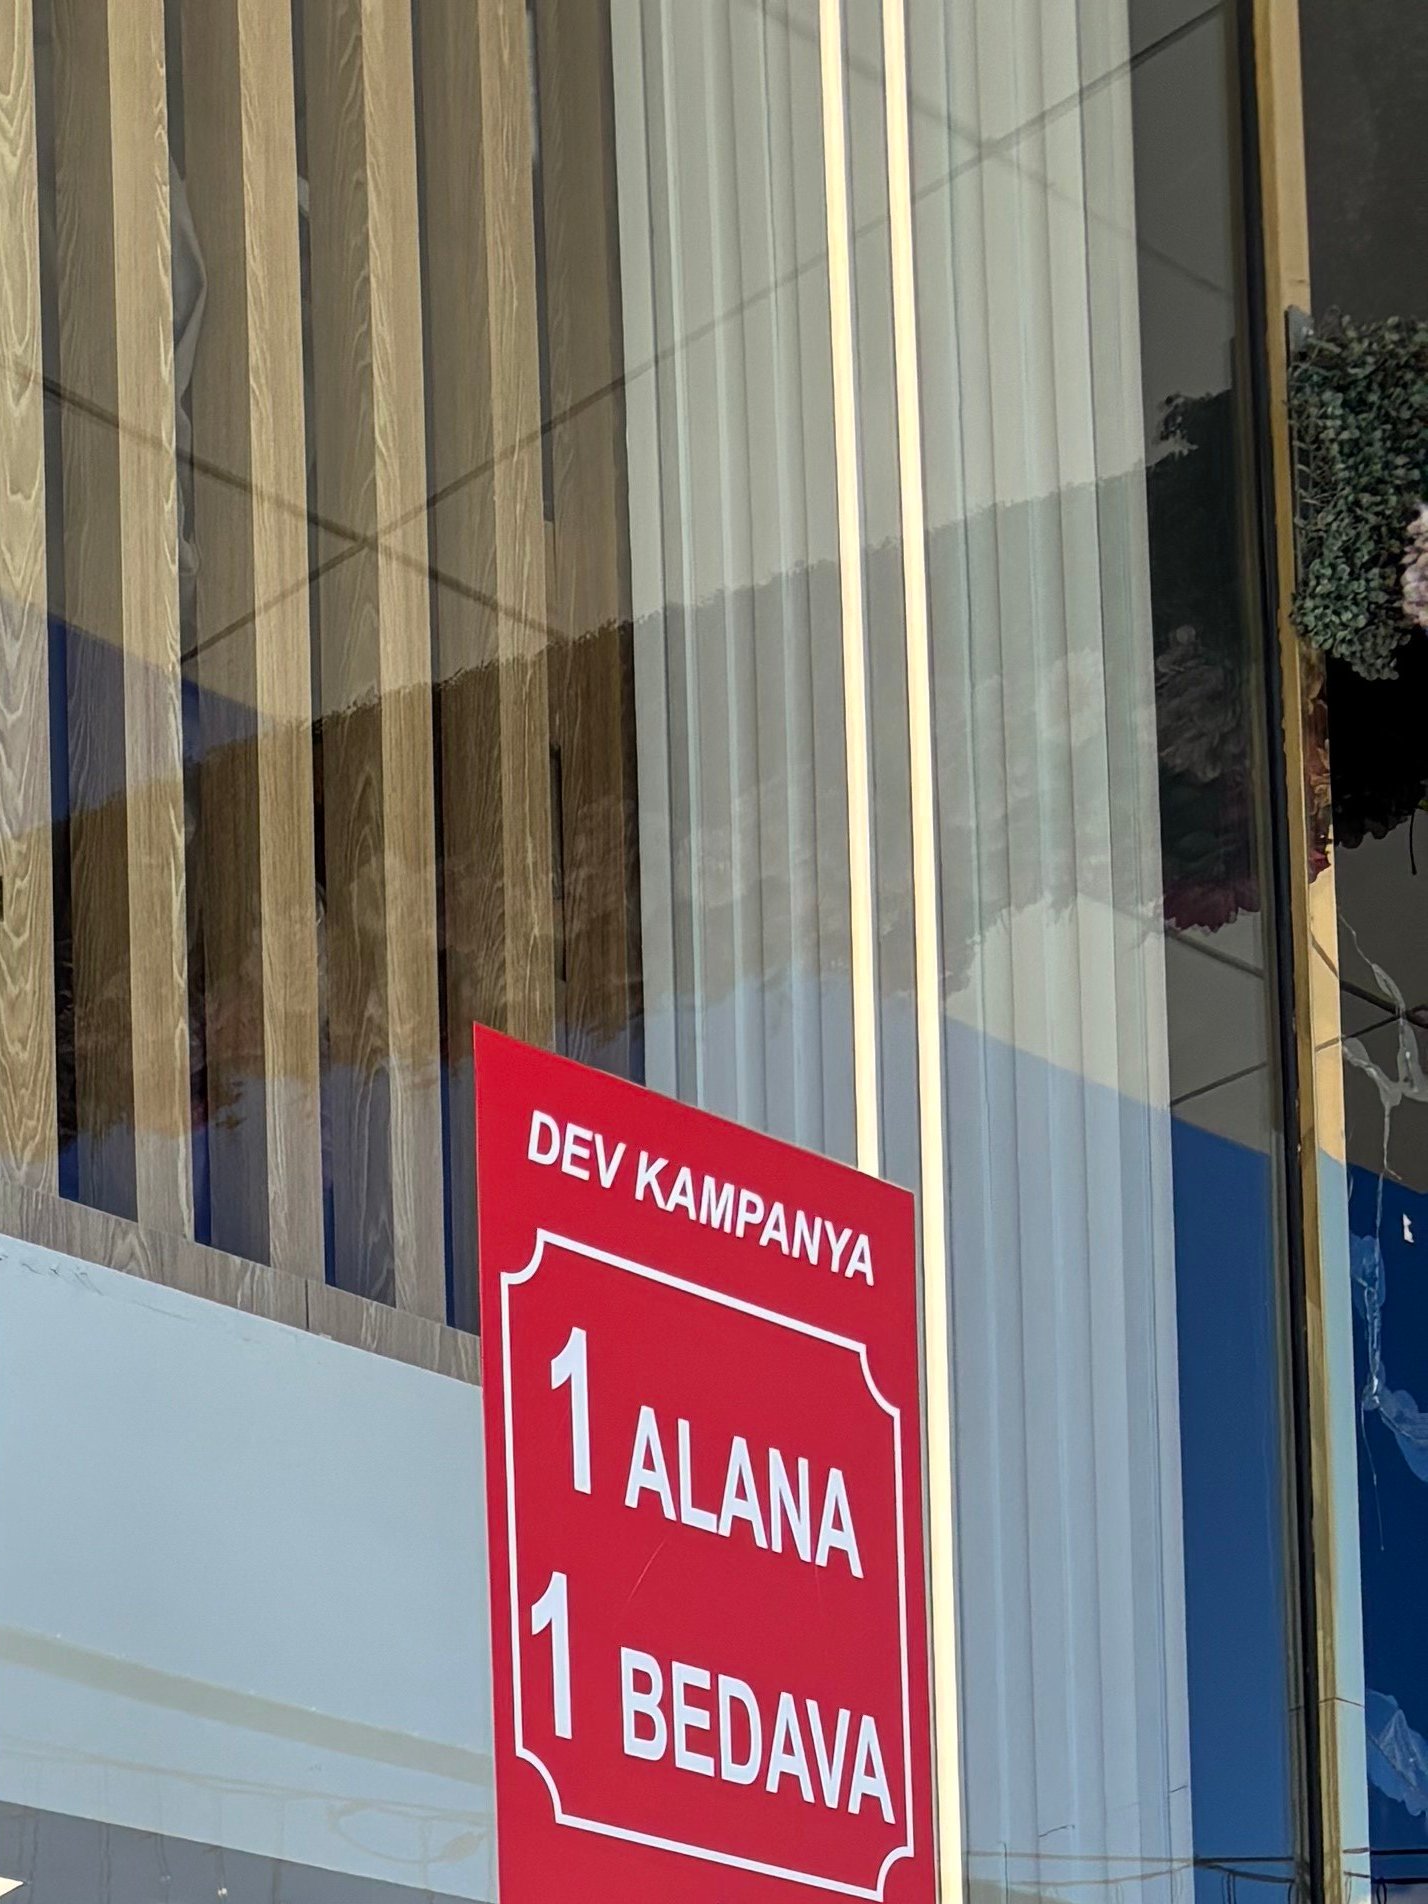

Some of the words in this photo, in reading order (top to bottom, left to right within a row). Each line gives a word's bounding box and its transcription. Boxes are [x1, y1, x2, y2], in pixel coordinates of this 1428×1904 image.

[527, 1110, 627, 1189] DEV
[635, 1150, 874, 1286] KAMPANYA
[550, 1326, 591, 1495] 1
[624, 1405, 864, 1579] ALANA
[531, 1571, 573, 1740] 1
[620, 1646, 896, 1825] BEDAVA
